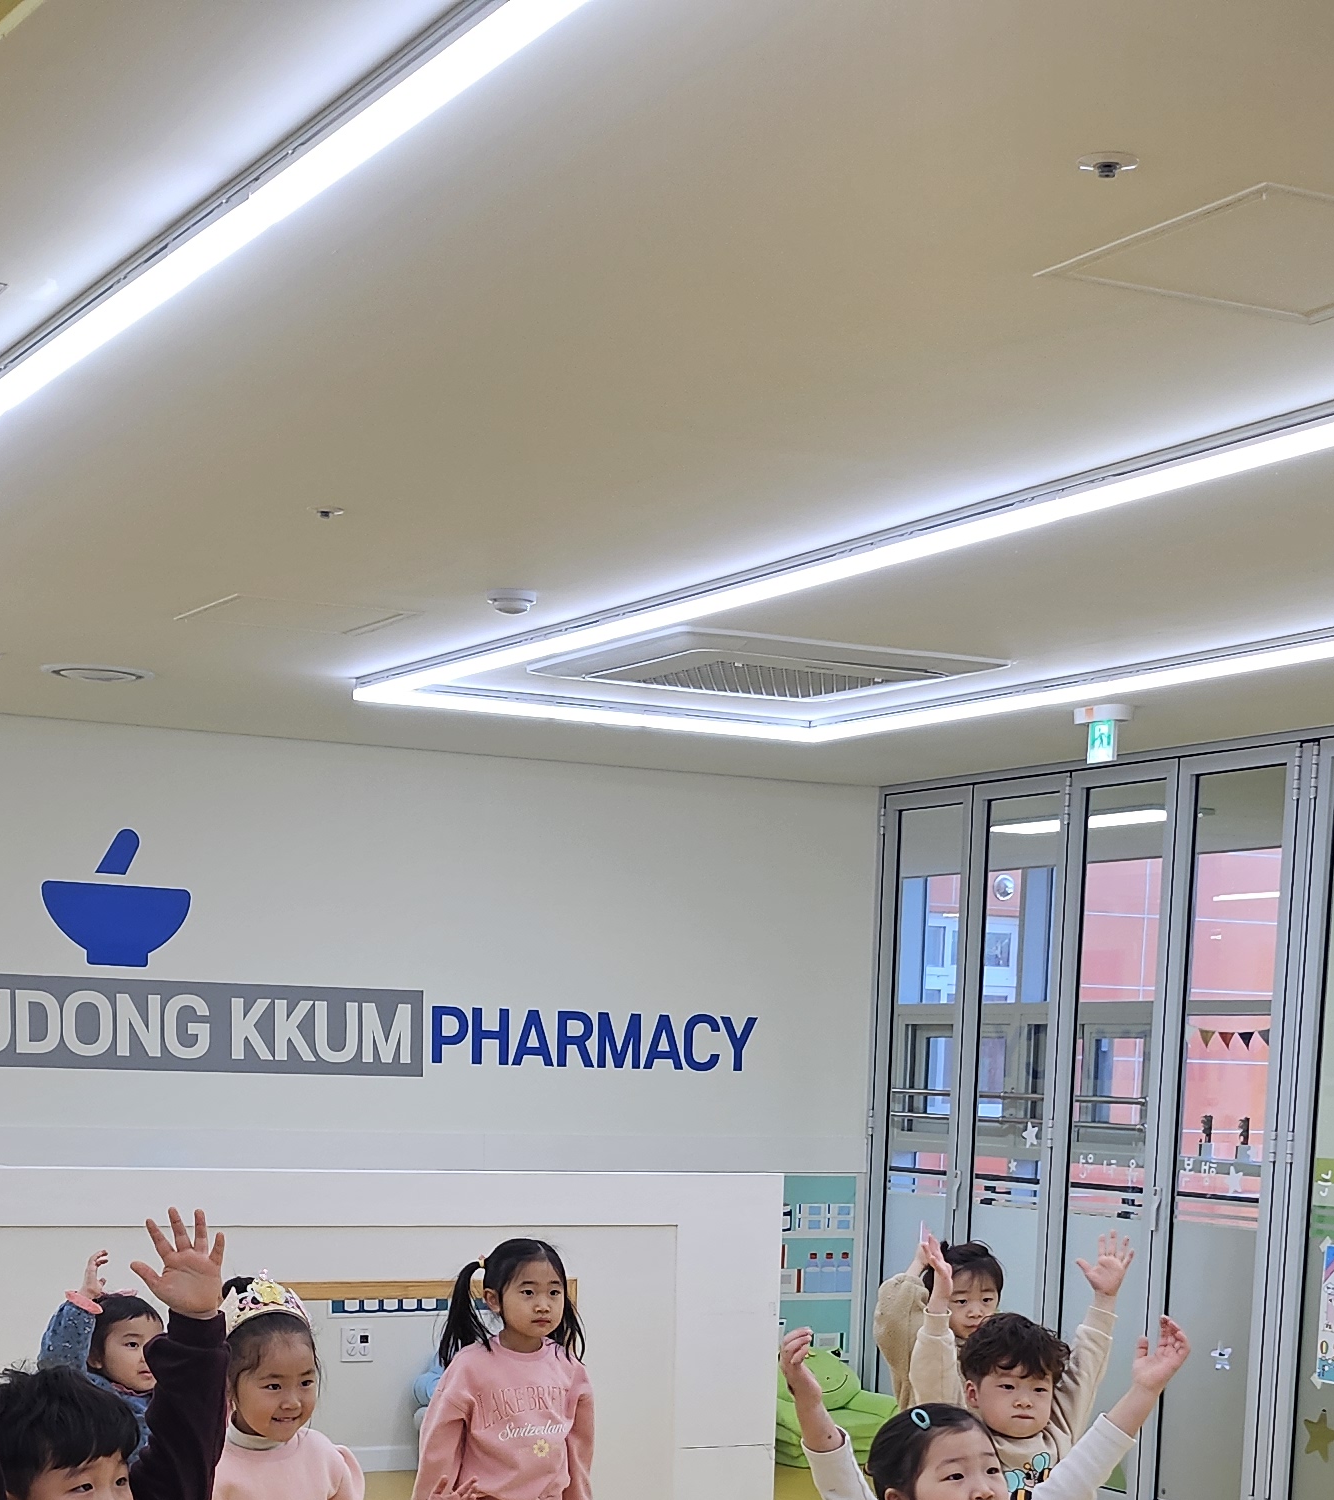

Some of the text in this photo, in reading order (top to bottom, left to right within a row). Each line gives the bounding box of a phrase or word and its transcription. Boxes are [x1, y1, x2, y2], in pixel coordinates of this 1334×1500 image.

[231, 997, 412, 1064] KKUM
[431, 1005, 759, 1072] PHARMACY
[477, 1388, 525, 1429] LAKE
